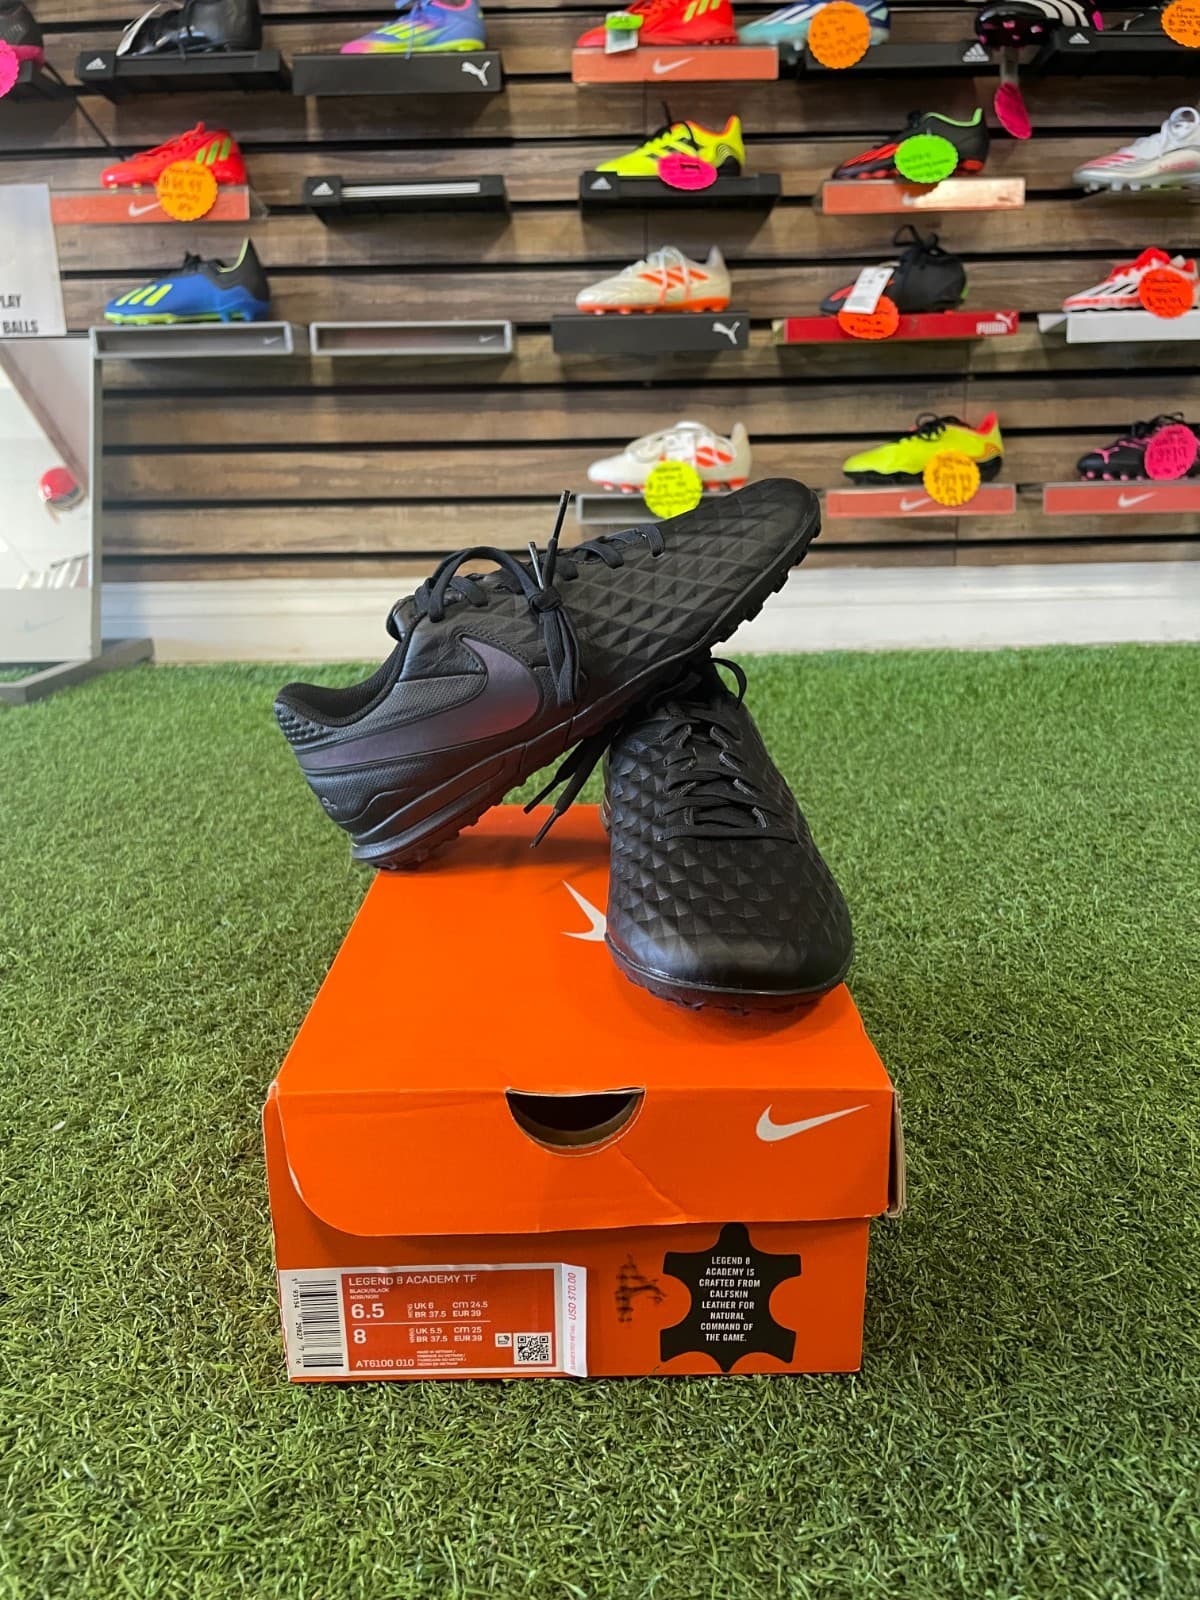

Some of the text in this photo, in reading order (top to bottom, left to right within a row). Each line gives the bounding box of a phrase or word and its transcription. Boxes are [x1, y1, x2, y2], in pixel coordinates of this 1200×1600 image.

[3, 320, 39, 334] BALLS
[711, 1256, 751, 1265] LEGEND 8
[705, 1267, 755, 1277] ACADEMY IS
[348, 1274, 477, 1286] LEGEND 8 ACADEMY TF
[699, 1279, 760, 1288] CRAFTED FROM
[567, 1272, 577, 1301] $70.00
[709, 1290, 749, 1298] CALFSKIN
[414, 1302, 427, 1310] UK
[702, 1300, 755, 1309] LEATHER FOR
[351, 1303, 385, 1319] 6.5
[568, 1302, 577, 1321] USD
[710, 1311, 745, 1320] NATURAL
[700, 1322, 753, 1331] COMMAND OF
[353, 1328, 367, 1344] 8
[430, 1335, 448, 1343] 37.5
[705, 1333, 747, 1342] THE GAME.
[355, 1359, 394, 1368] AT6100
[396, 1359, 415, 1367] 010
